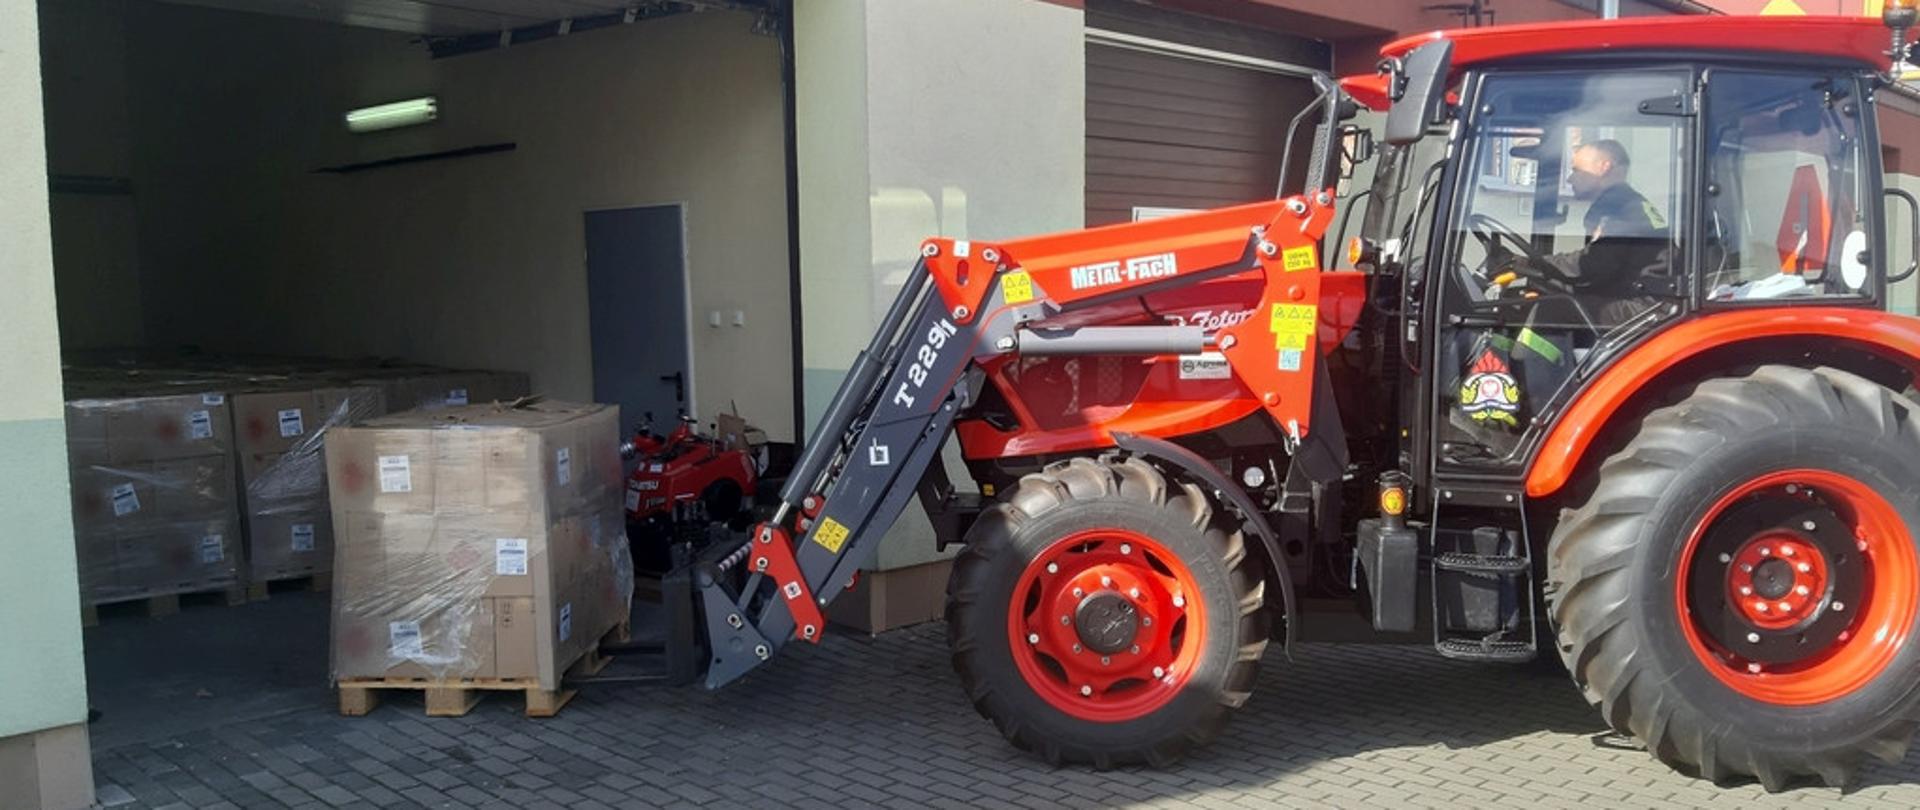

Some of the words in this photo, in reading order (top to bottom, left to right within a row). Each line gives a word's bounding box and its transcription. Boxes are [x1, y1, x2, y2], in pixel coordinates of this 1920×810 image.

[1070, 252, 1177, 290] METAL-FACH
[1190, 309, 1257, 333] Zetor
[894, 382, 914, 408] T
